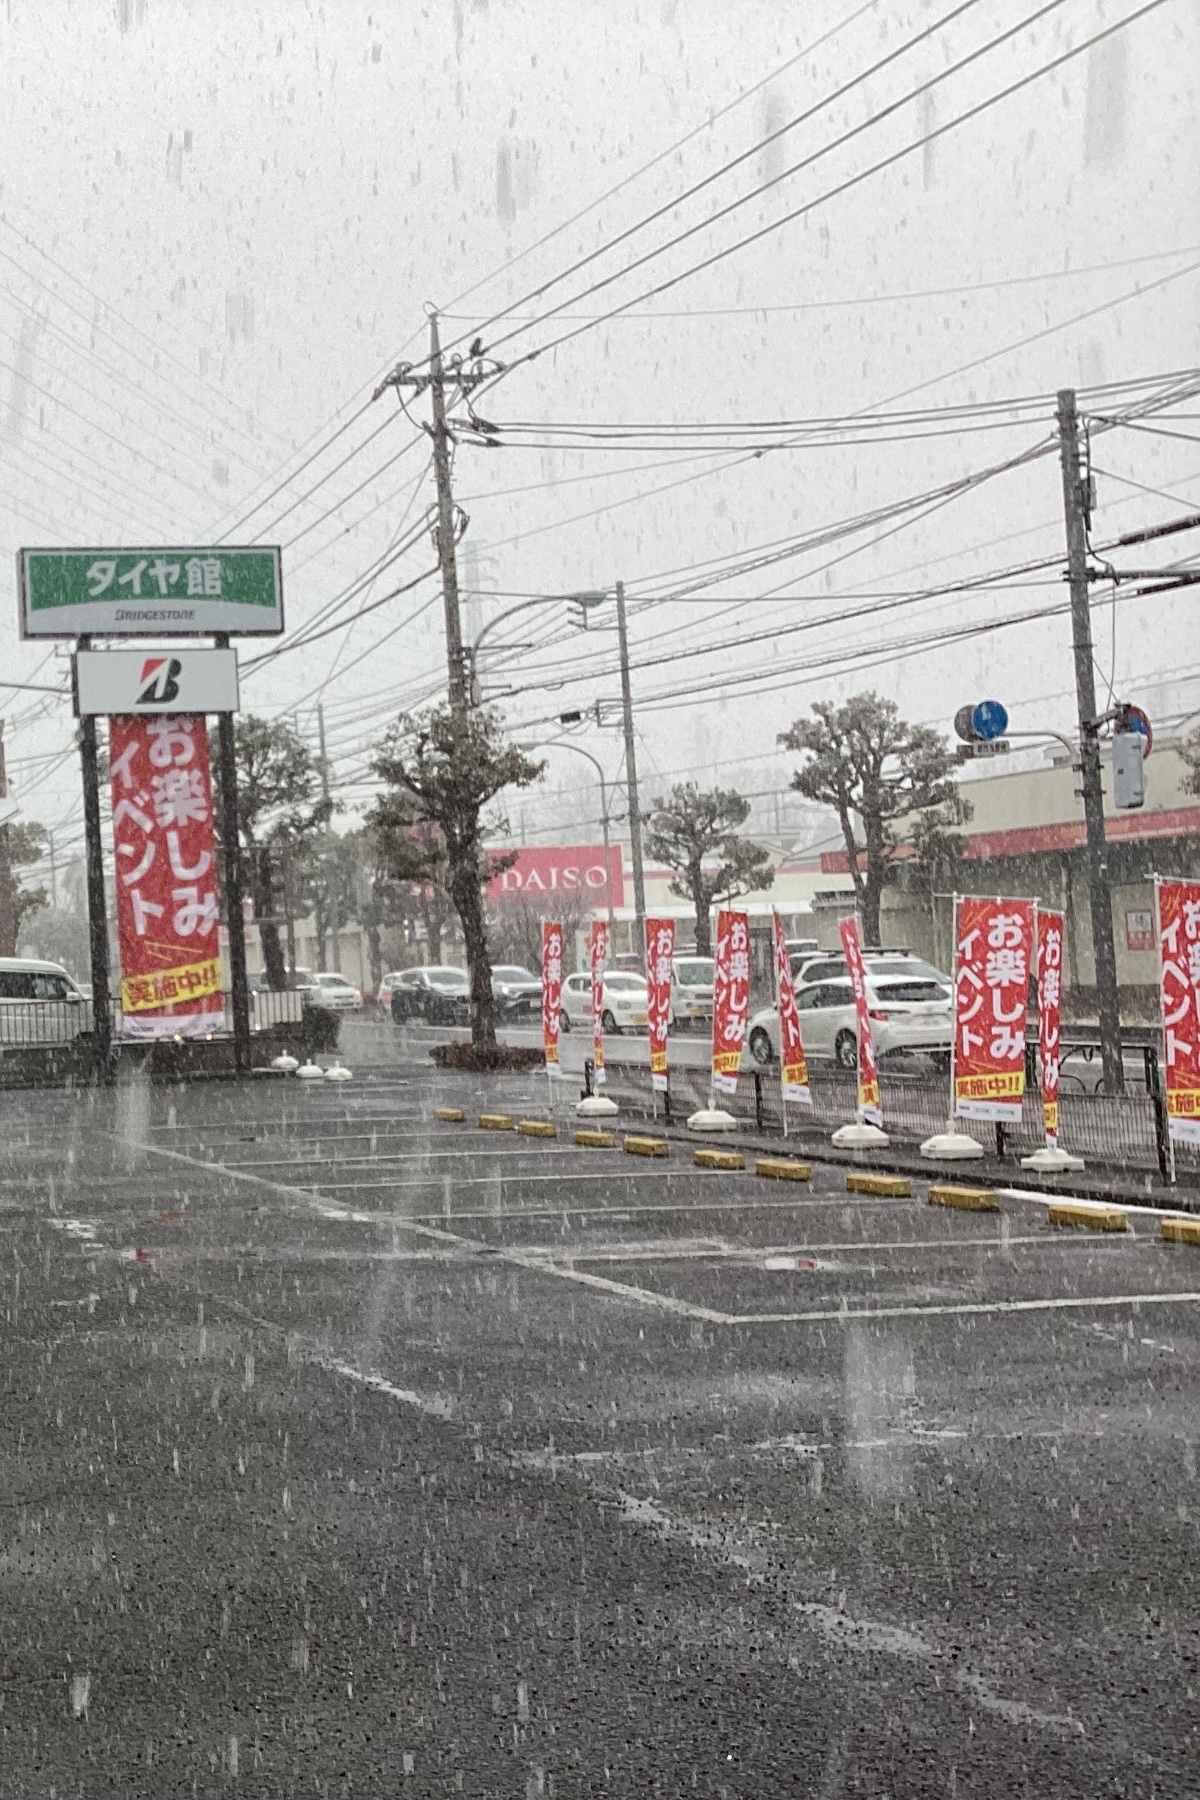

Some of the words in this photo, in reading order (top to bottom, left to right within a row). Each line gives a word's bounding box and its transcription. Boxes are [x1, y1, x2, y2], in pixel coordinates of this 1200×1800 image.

[86, 557, 222, 597] タイヤ館
[114, 609, 196, 621] BRIDGESTONE
[110, 740, 165, 936] イベント
[146, 716, 220, 936] お楽しみ
[500, 865, 607, 891] DAISO
[548, 933, 561, 1035] お楽しみ
[656, 929, 673, 1042] お楽しみ
[724, 922, 749, 1042] お楽しみ
[957, 928, 984, 1057] イベント
[986, 913, 1026, 1060] お楽しみ
[1043, 929, 1060, 1089] お楽しみ
[1161, 917, 1193, 1066] イベント
